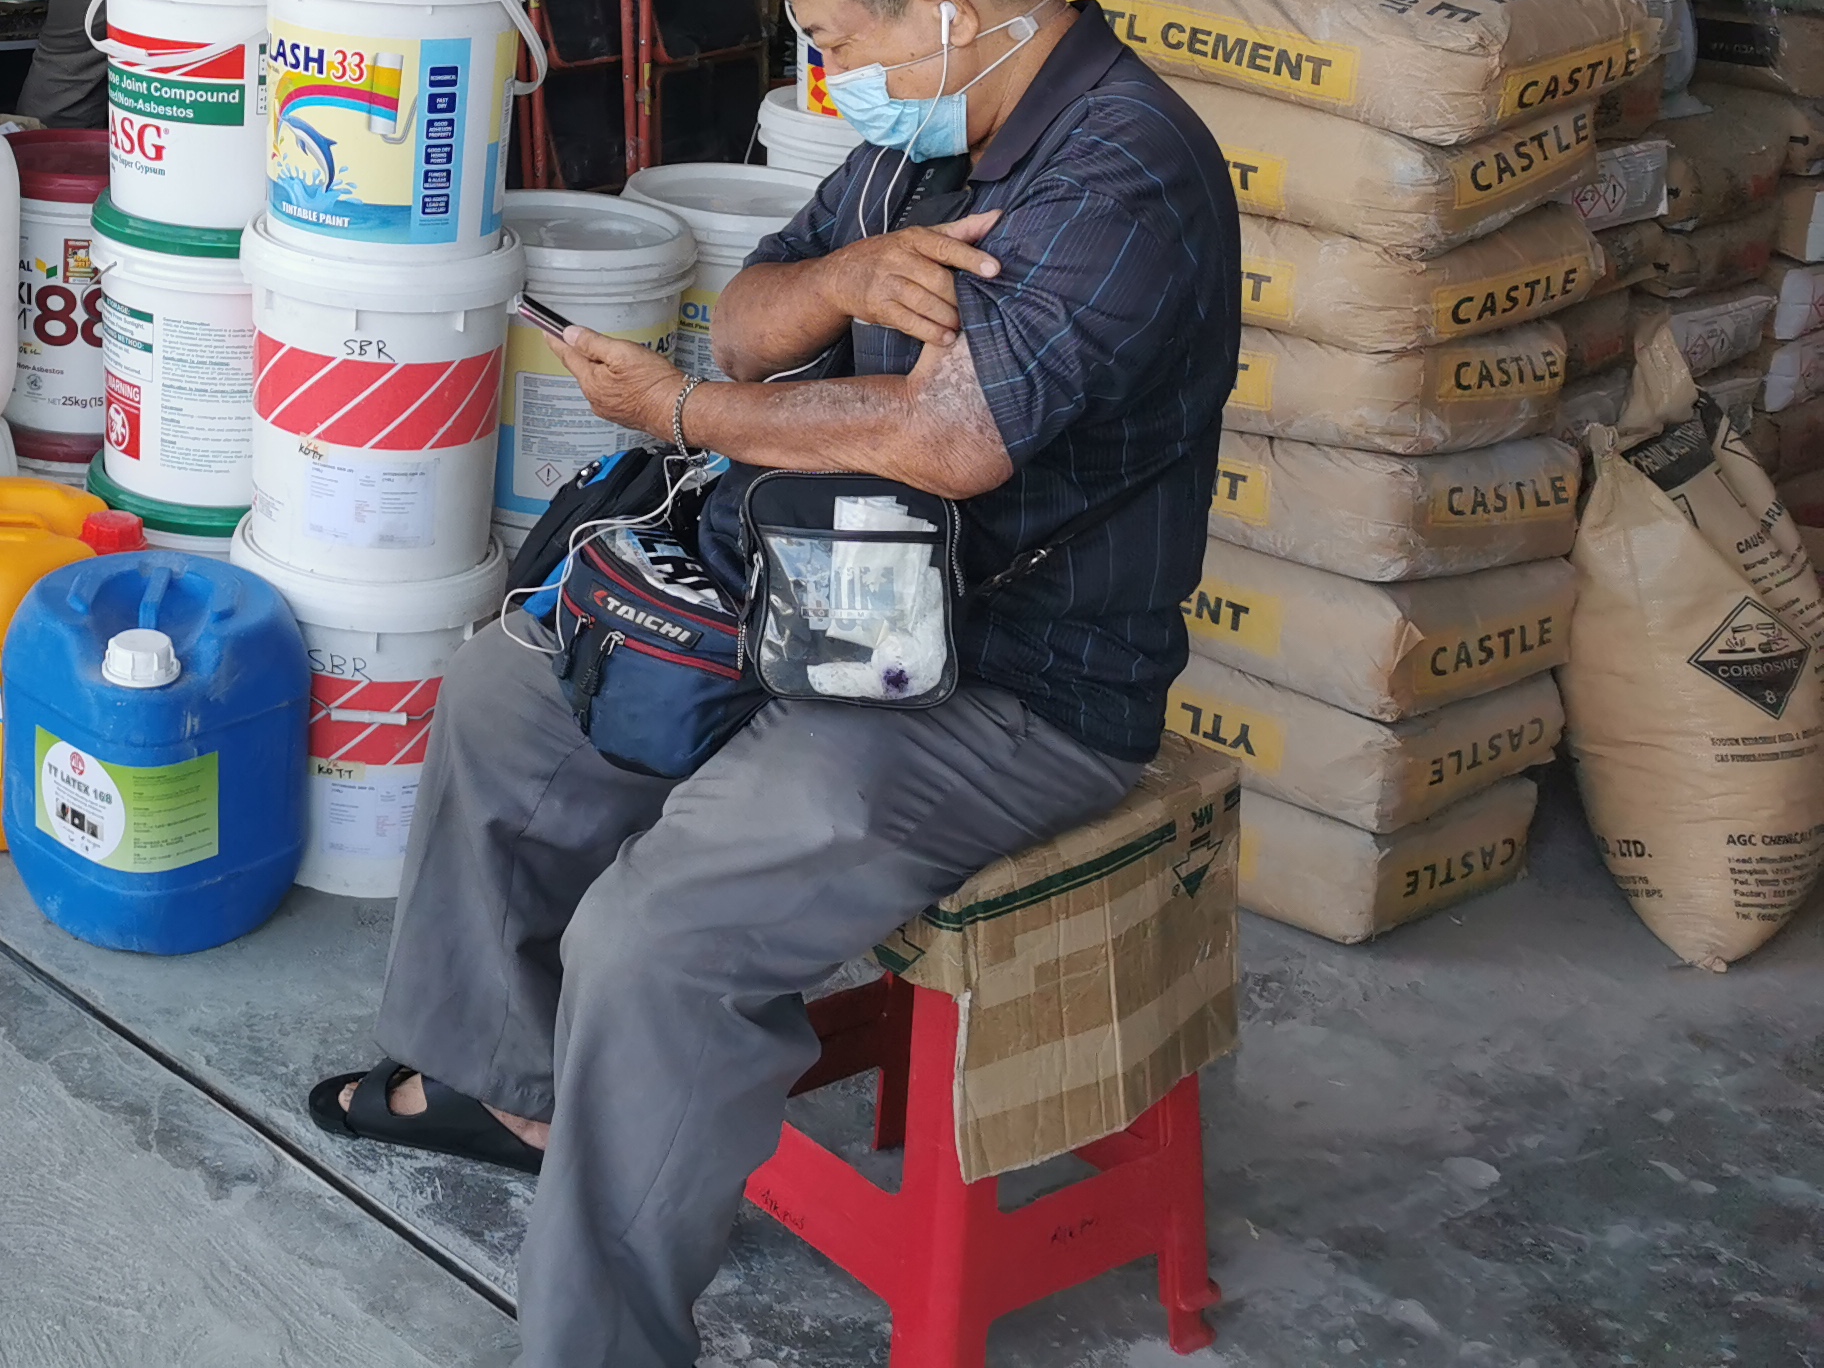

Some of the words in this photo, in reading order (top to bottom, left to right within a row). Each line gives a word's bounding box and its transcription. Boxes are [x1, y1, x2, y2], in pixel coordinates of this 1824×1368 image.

[331, 49, 366, 83] 33
[1160, 21, 1333, 88] CEMENT
[121, 72, 148, 96] Joint
[150, 81, 240, 105] Compound
[1517, 45, 1641, 110] CASTLE
[110, 109, 167, 162] ASG
[1469, 115, 1590, 192] CASTLE
[119, 153, 134, 169] Super
[135, 160, 166, 177] Gypsum
[282, 200, 318, 224] TINTABLE
[319, 211, 350, 228] PAINT
[1451, 268, 1579, 326] CASTLE
[117, 329, 145, 349] METHOD:
[344, 339, 395, 362] SBR
[1453, 351, 1560, 392] CASTLE
[62, 396, 88, 409] 25kg
[1446, 476, 1570, 517] CASTLE
[604, 594, 694, 644] TAICHI
[307, 649, 372, 682] SBR
[1430, 617, 1554, 677] CASTLE
[1717, 656, 1799, 679] CORROSIVE
[1765, 690, 1777, 705] 8
[1180, 702, 1256, 757] YTL
[1428, 717, 1546, 786] CASTLE
[48, 762, 58, 778] TT
[60, 769, 90, 795] LATEX
[93, 789, 113, 805] 168
[1727, 834, 1757, 846] AGC
[1403, 838, 1517, 898] CASTLE
[1734, 889, 1767, 900] Factory
